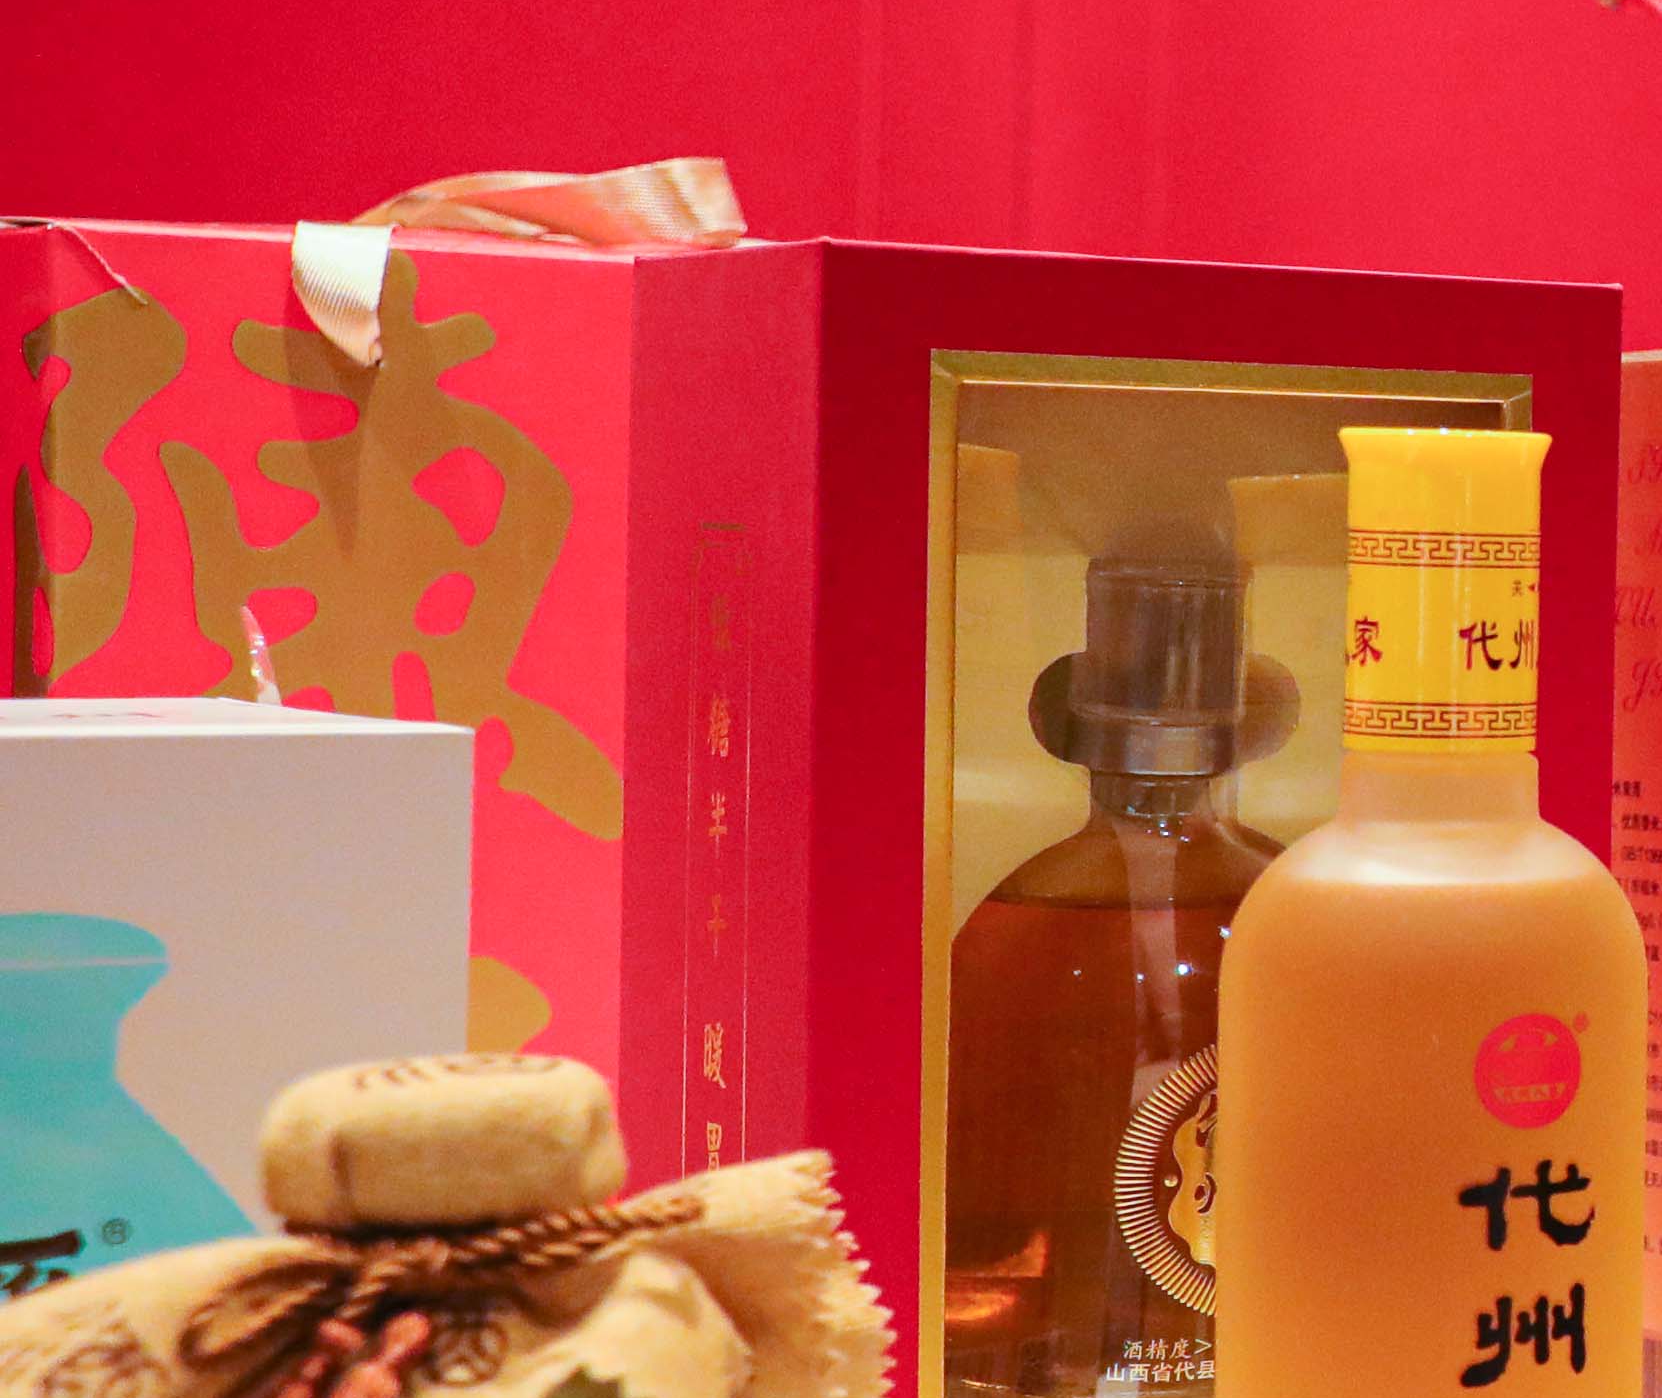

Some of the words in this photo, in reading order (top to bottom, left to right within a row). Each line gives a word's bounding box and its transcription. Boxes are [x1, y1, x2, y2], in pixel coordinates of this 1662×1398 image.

[1106, 1359, 1215, 1383] 山西省代县
